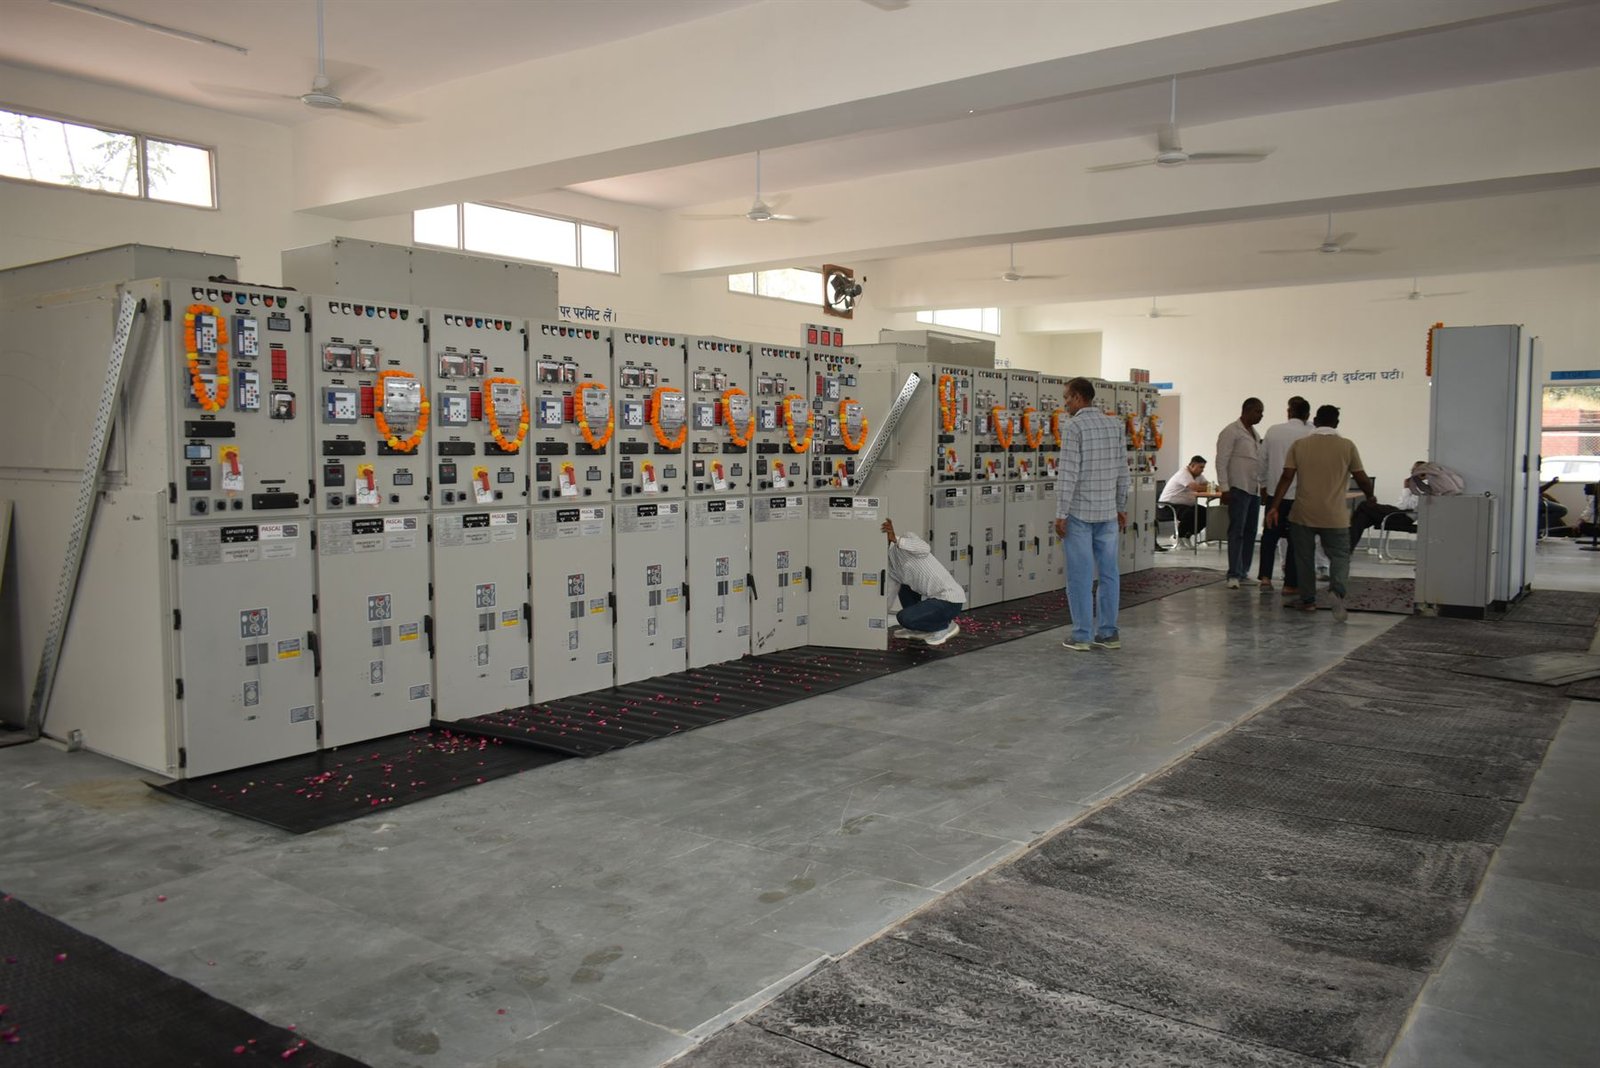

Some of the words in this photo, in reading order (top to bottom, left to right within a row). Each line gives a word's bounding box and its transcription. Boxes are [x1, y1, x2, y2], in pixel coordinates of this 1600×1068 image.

[559, 305, 571, 318] पर
[573, 305, 601, 321] परमिट
[1320, 371, 1337, 383] हटी
[1343, 370, 1377, 384] दुर्घटना
